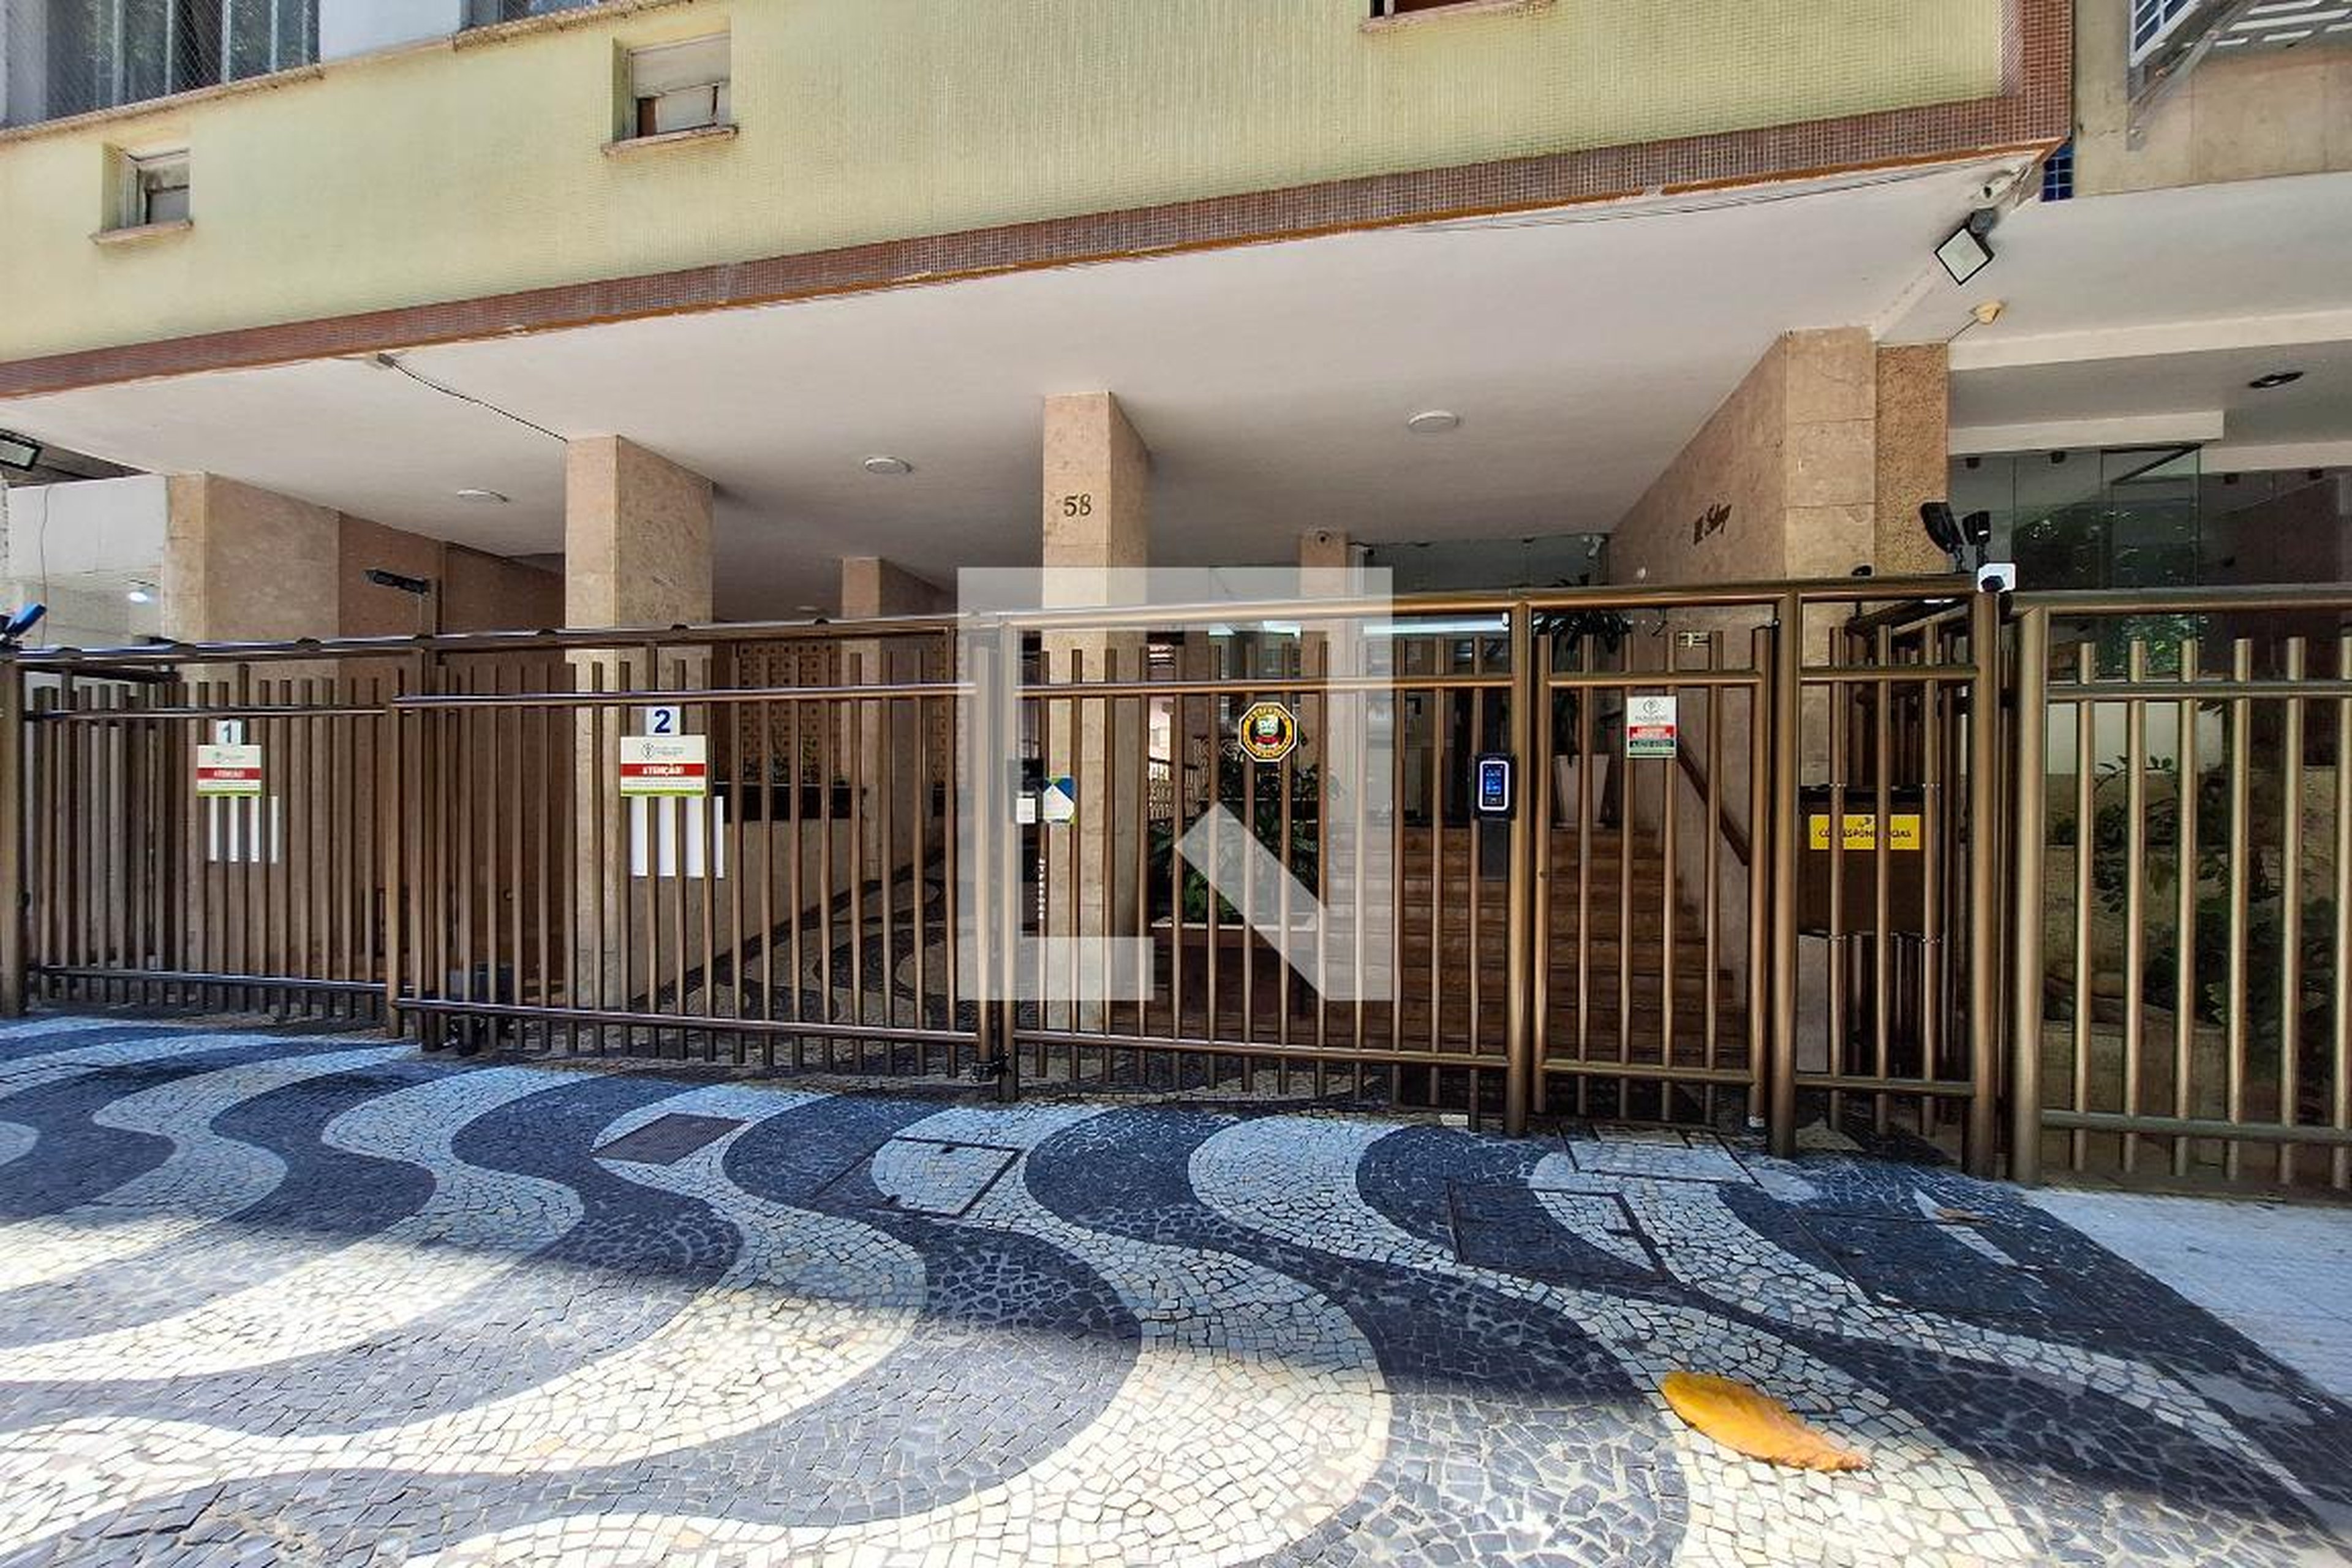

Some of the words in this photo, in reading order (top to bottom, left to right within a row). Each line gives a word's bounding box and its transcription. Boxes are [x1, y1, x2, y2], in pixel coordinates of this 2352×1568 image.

[1063, 493, 1091, 516] 58
[654, 709, 671, 733] 2
[223, 723, 232, 743] 1
